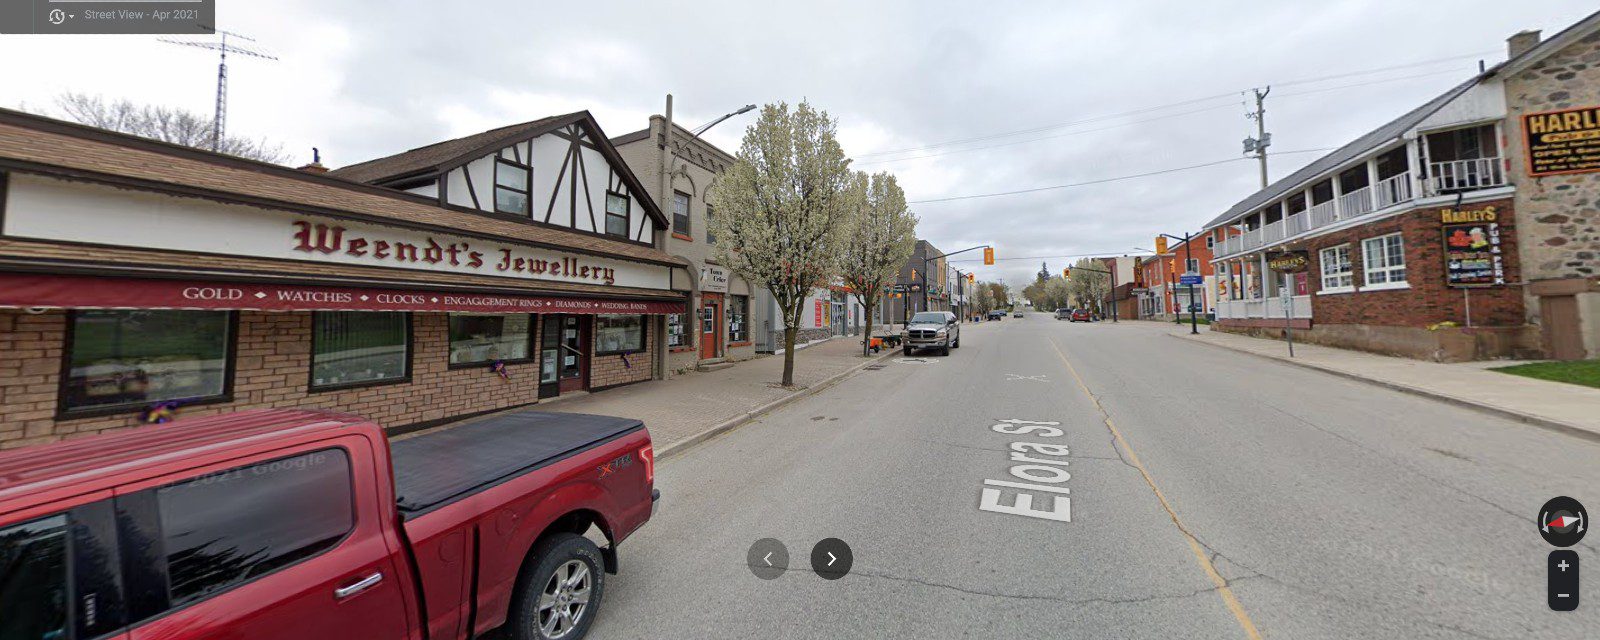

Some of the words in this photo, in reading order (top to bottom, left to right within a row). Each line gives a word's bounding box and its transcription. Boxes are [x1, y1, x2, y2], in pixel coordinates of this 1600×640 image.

[292, 220, 484, 268] Weendt's
[495, 247, 616, 285] Jewellery
[182, 287, 243, 300] GOLD
[277, 290, 352, 303] WATCHES
[376, 293, 425, 304] CLOCKS
[519, 299, 543, 308] RINGS
[555, 300, 592, 309] DIAMONDS
[601, 302, 629, 310] WEDDING
